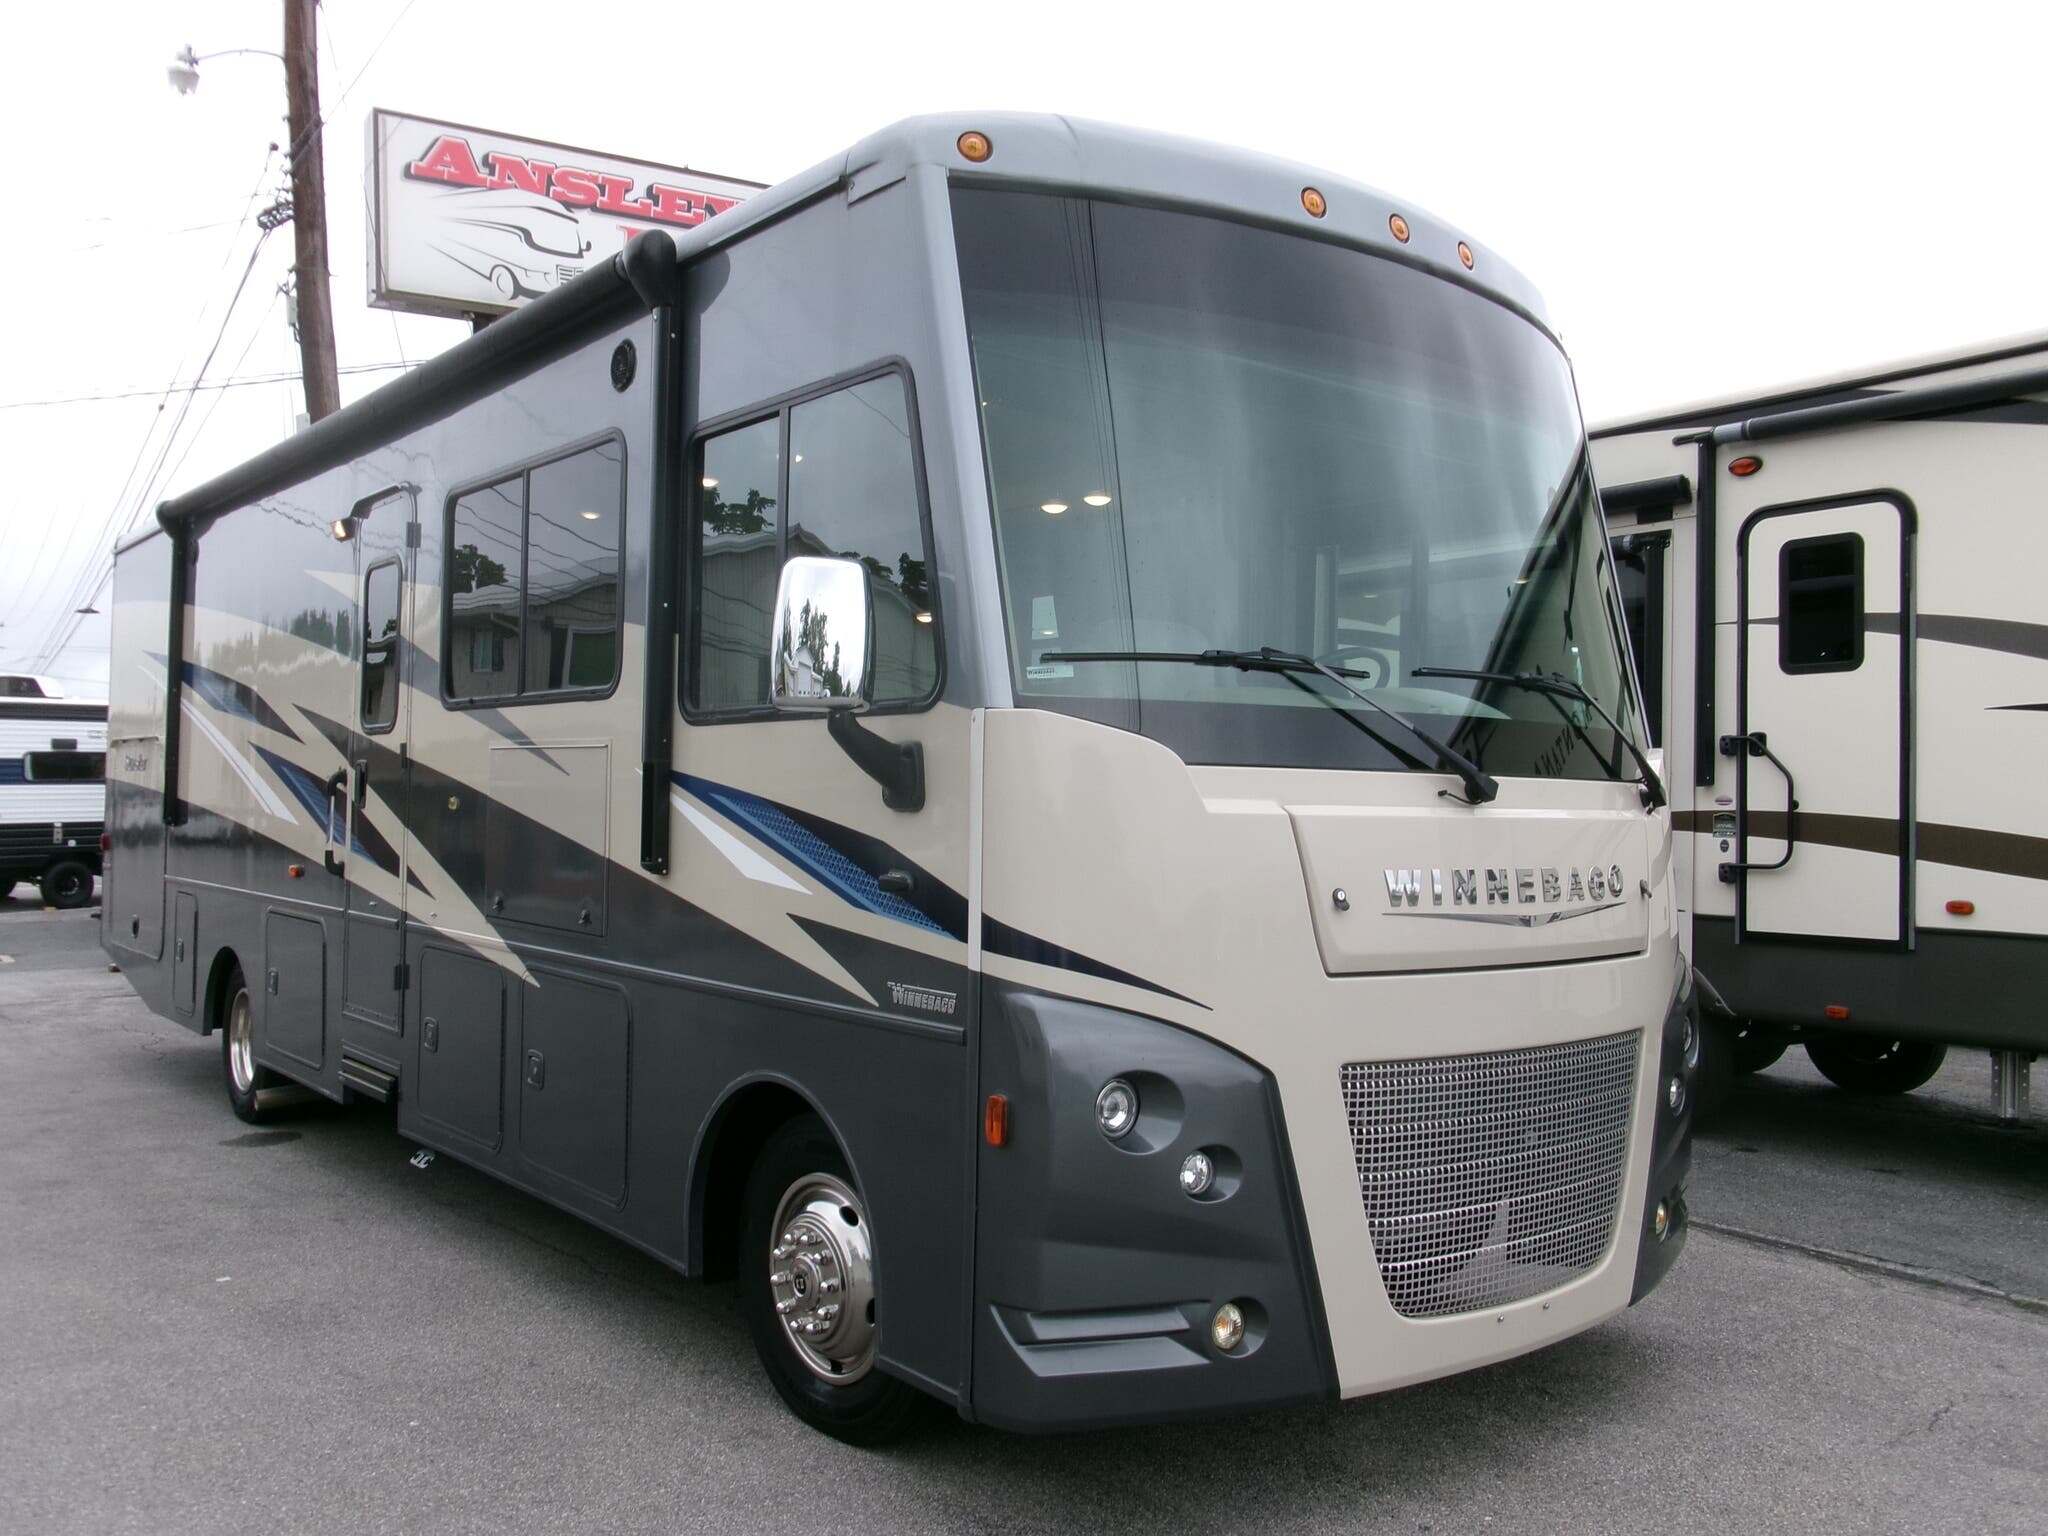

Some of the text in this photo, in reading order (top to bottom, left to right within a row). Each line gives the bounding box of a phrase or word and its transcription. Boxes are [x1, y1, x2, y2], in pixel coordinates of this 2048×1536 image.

[407, 135, 742, 228] ANSLE
[1382, 863, 1625, 908] WINNEBAGO
[887, 981, 957, 1015] WINNEBAGO
